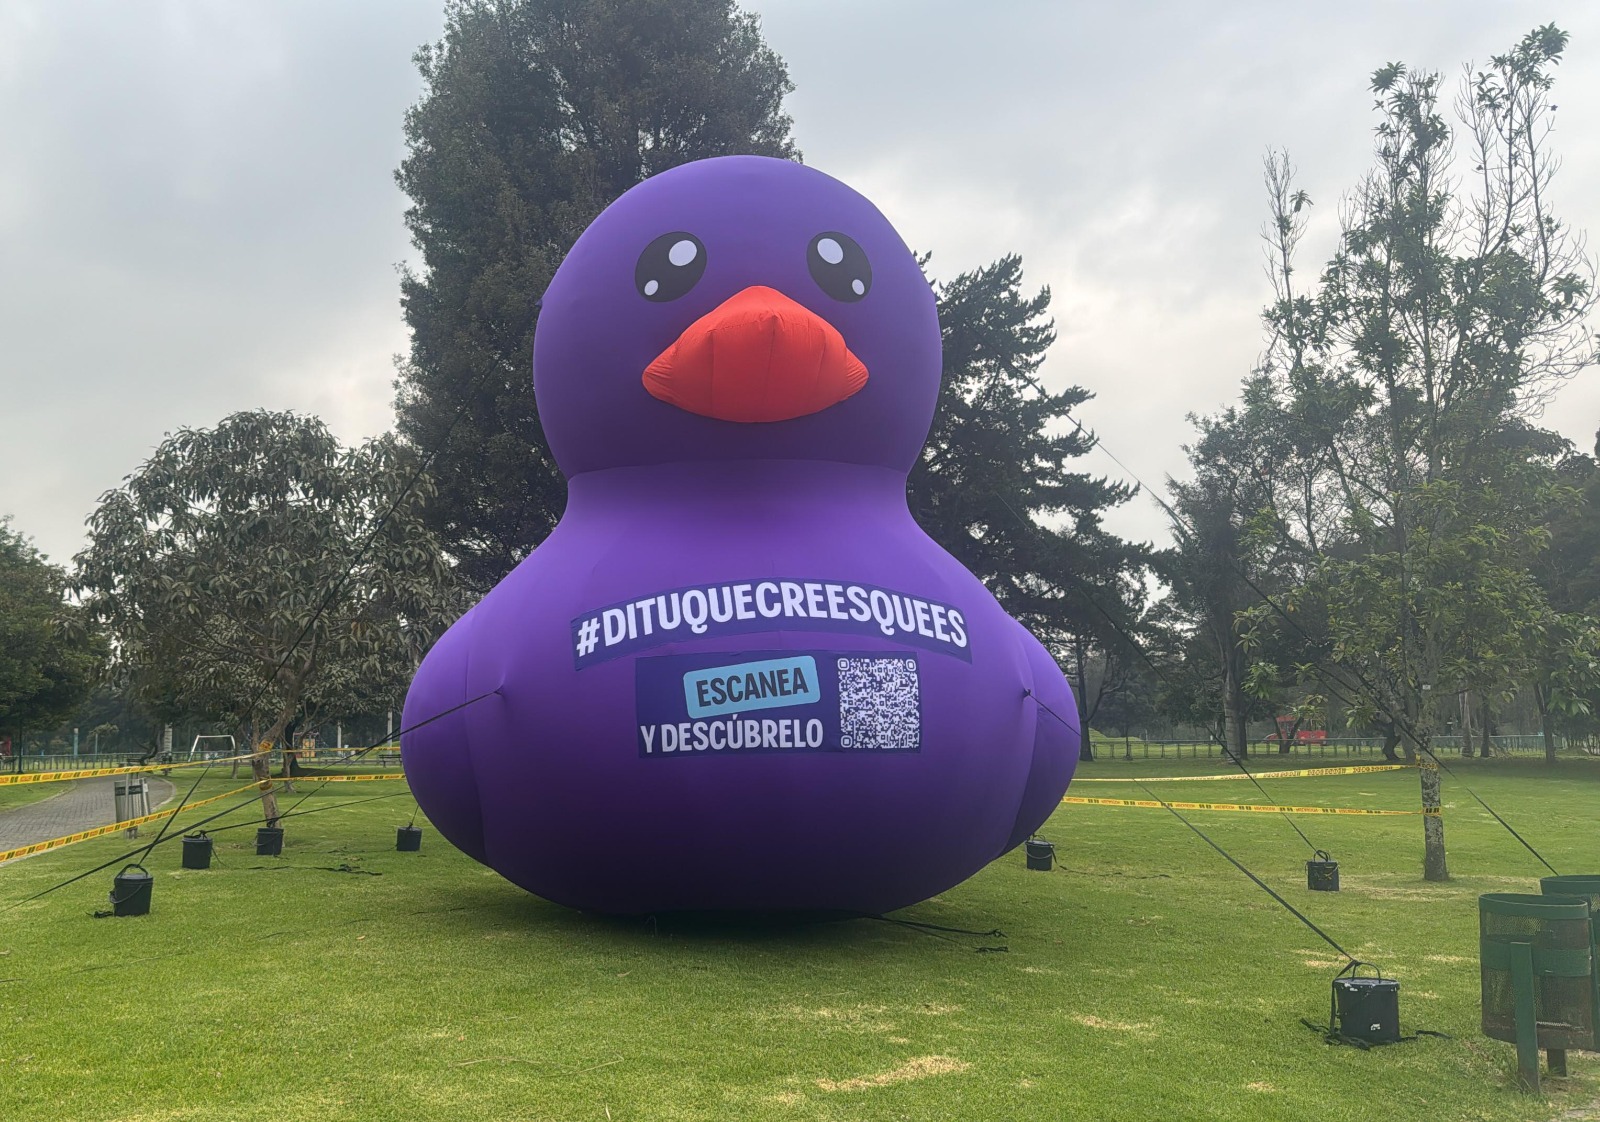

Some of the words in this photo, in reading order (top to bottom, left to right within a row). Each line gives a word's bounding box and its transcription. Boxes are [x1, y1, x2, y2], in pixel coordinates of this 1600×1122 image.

[576, 581, 968, 657] #DITUQUECREESQUEES
[696, 667, 809, 707] ESCANEA
[640, 724, 657, 754] Y
[661, 714, 824, 753] DESCÚBRELO
